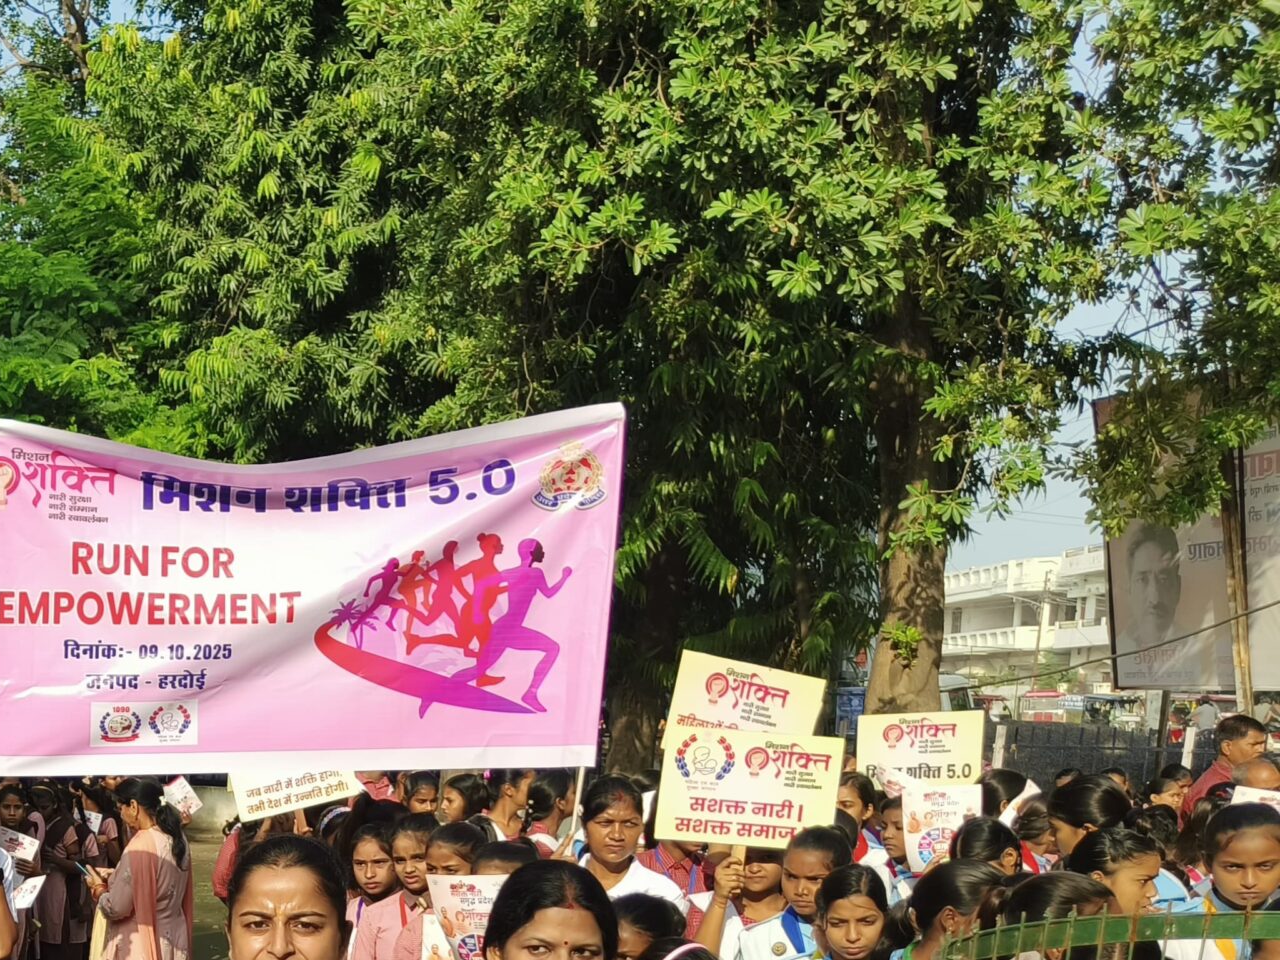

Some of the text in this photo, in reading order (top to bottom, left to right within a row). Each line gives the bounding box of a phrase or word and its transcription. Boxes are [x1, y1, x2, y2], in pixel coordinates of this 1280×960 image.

[11, 448, 49, 462] मिशन
[22, 450, 118, 508] शक्ति
[140, 458, 517, 513] मिशन शक्ति 5.0
[49, 493, 66, 501] नारी
[49, 503, 66, 511] नारी
[49, 512, 66, 521] नारी
[72, 541, 235, 578] RUN FOR
[138, 643, 232, 660] 09.10.2025
[86, 672, 140, 689] जनपद
[158, 669, 208, 690] हरदोई
[730, 673, 790, 709] शक्ति
[905, 717, 957, 748] शक्ति
[770, 742, 832, 779] शक्ति
[947, 764, 972, 779] 5.0
[246, 786, 262, 798] जब
[263, 780, 283, 794] नारी
[247, 800, 266, 815] तभी
[689, 796, 748, 815] सशक्त
[675, 817, 733, 836] सशक्त
